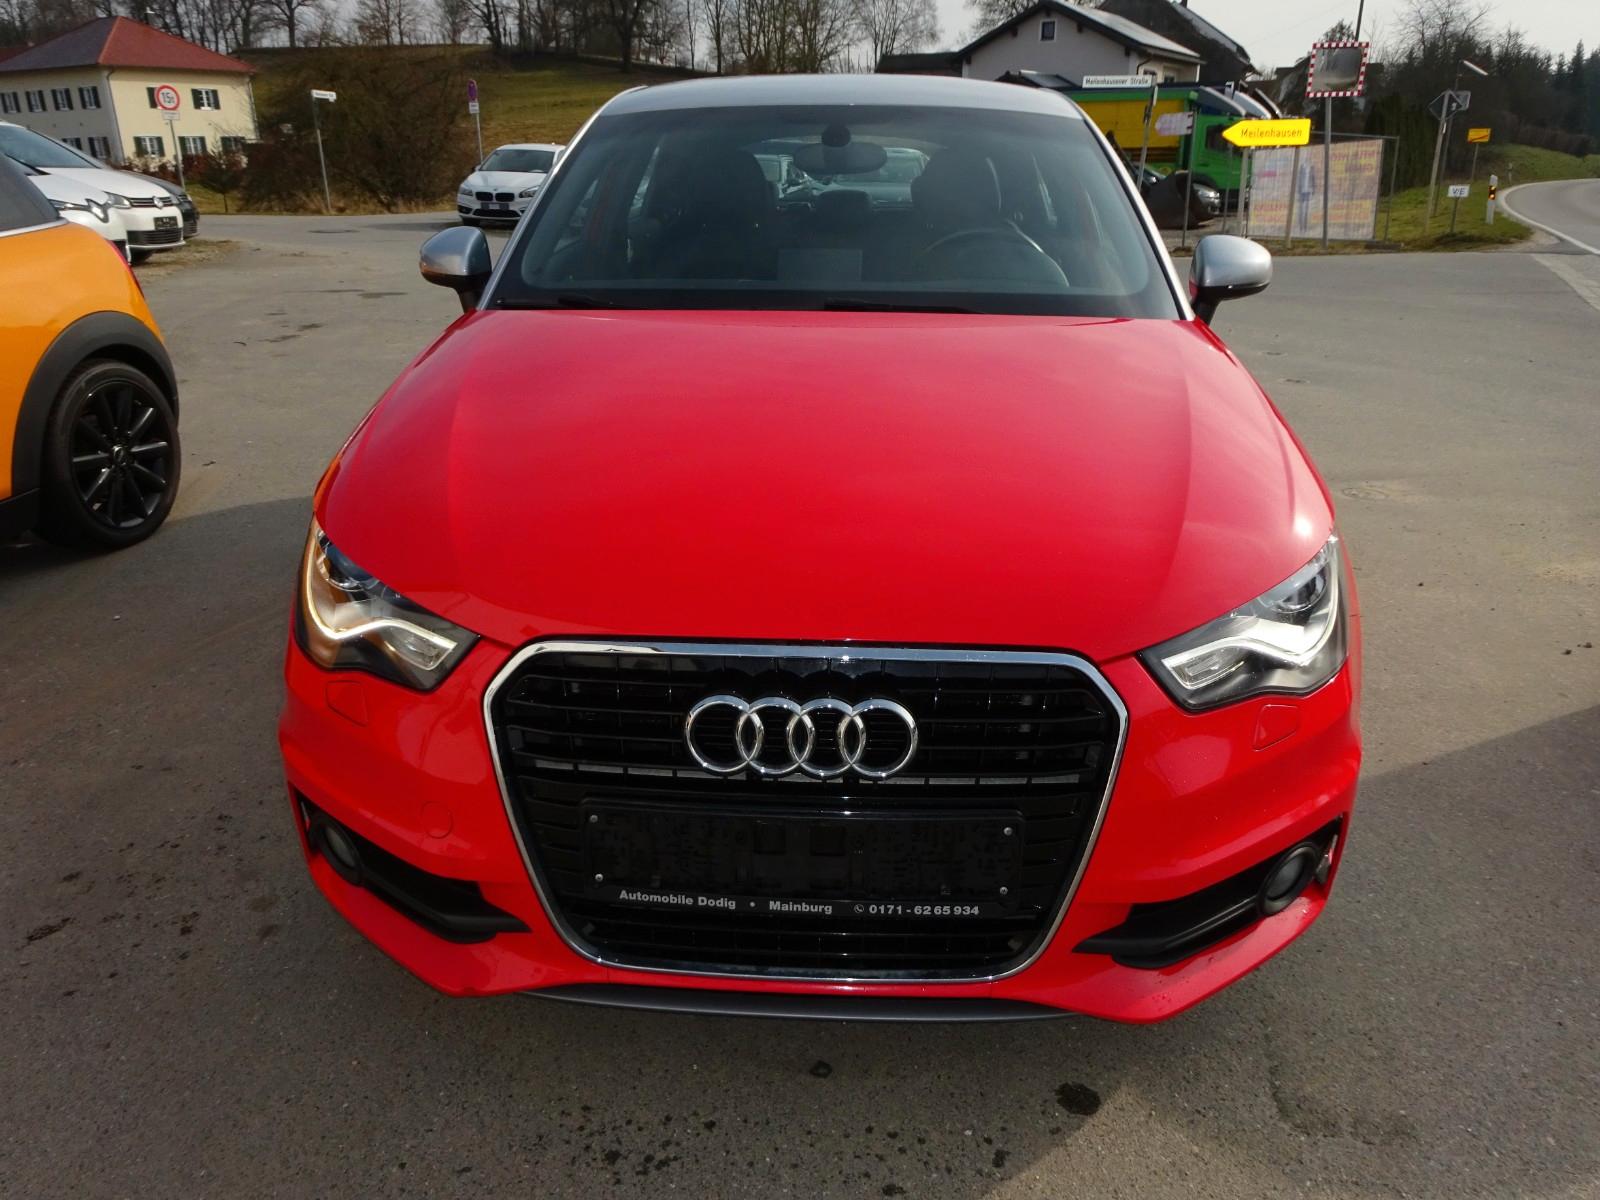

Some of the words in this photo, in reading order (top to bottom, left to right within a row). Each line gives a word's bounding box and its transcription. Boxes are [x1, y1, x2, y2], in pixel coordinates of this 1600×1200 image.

[1241, 128, 1303, 138] Meilenhausen
[619, 889, 694, 905] Automobile
[698, 896, 736, 909] Dodig
[769, 901, 832, 914] Mainburg
